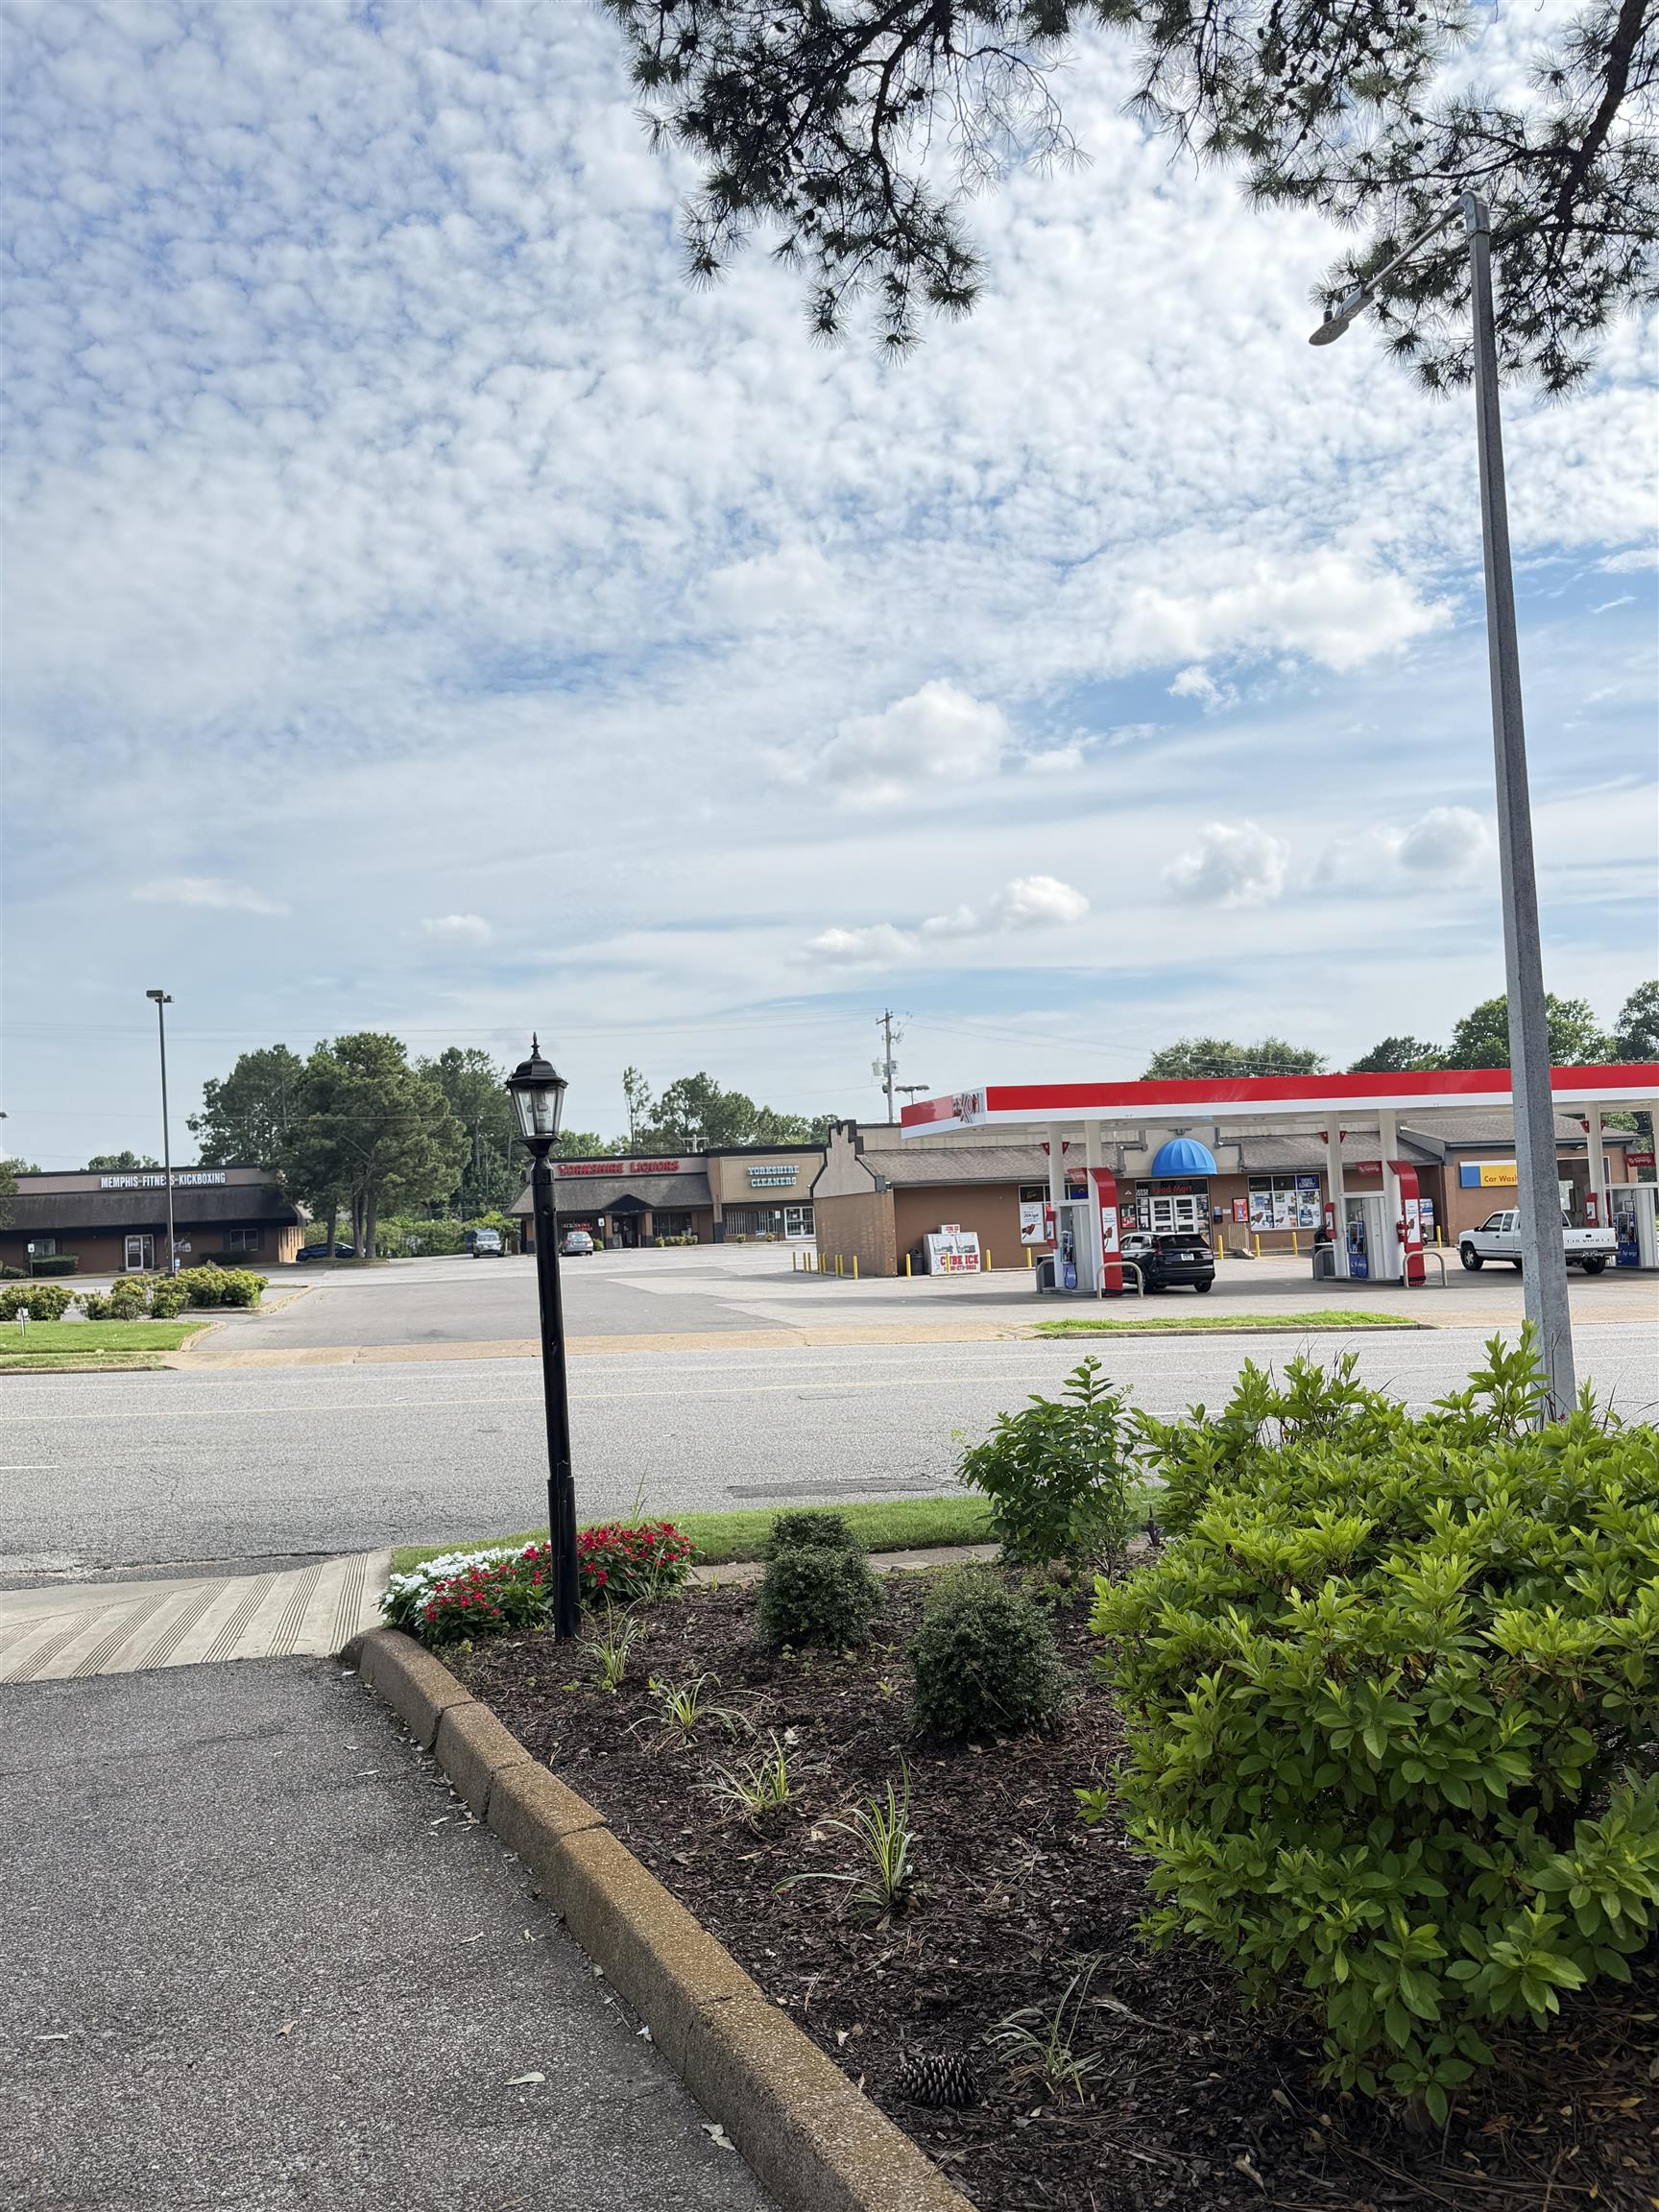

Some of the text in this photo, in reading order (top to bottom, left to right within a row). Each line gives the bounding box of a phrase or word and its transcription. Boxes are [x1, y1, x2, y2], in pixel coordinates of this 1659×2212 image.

[630, 1160, 680, 1173] LIQUORS
[747, 1165, 800, 1175] YORKSHIRE
[751, 1176, 797, 1188] CLEANERS
[965, 1254, 978, 1264] ICE
